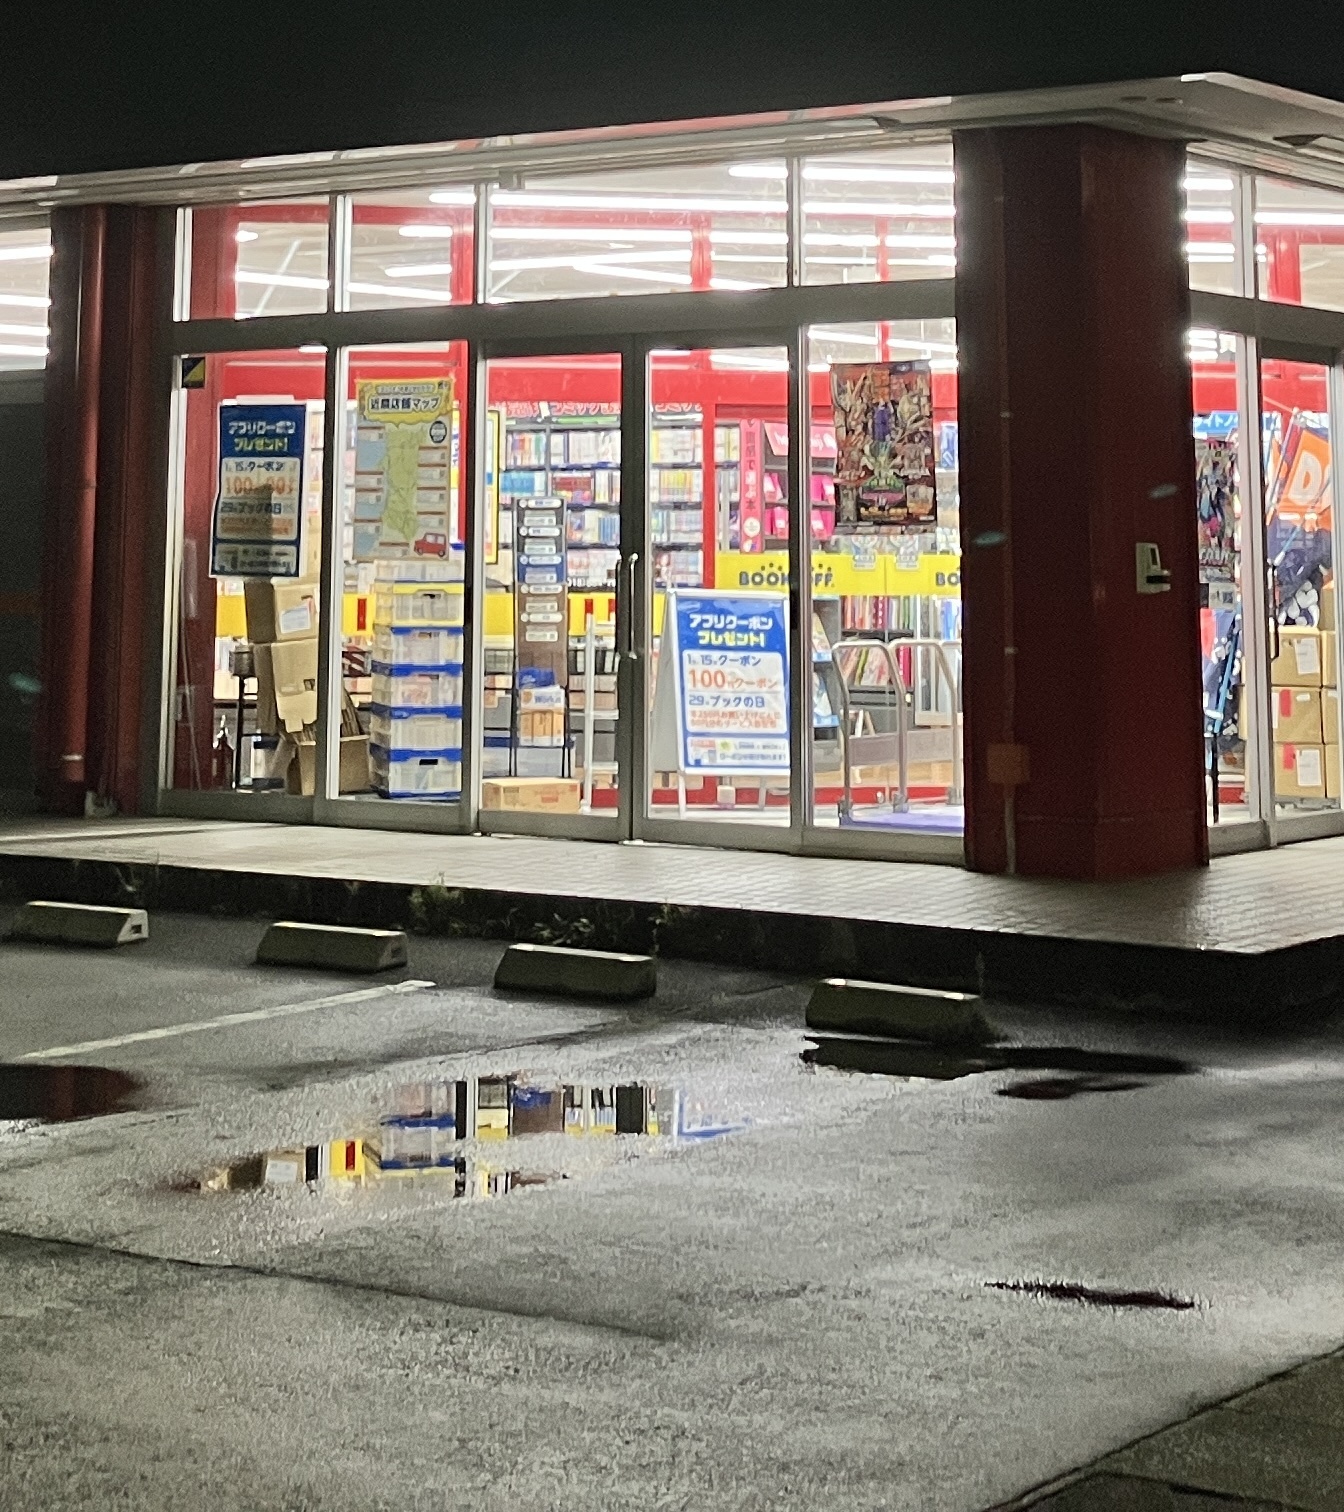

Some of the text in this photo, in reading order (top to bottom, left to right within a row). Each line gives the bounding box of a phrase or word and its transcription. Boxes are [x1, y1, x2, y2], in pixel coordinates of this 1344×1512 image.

[689, 614, 774, 631] アプリクーポン
